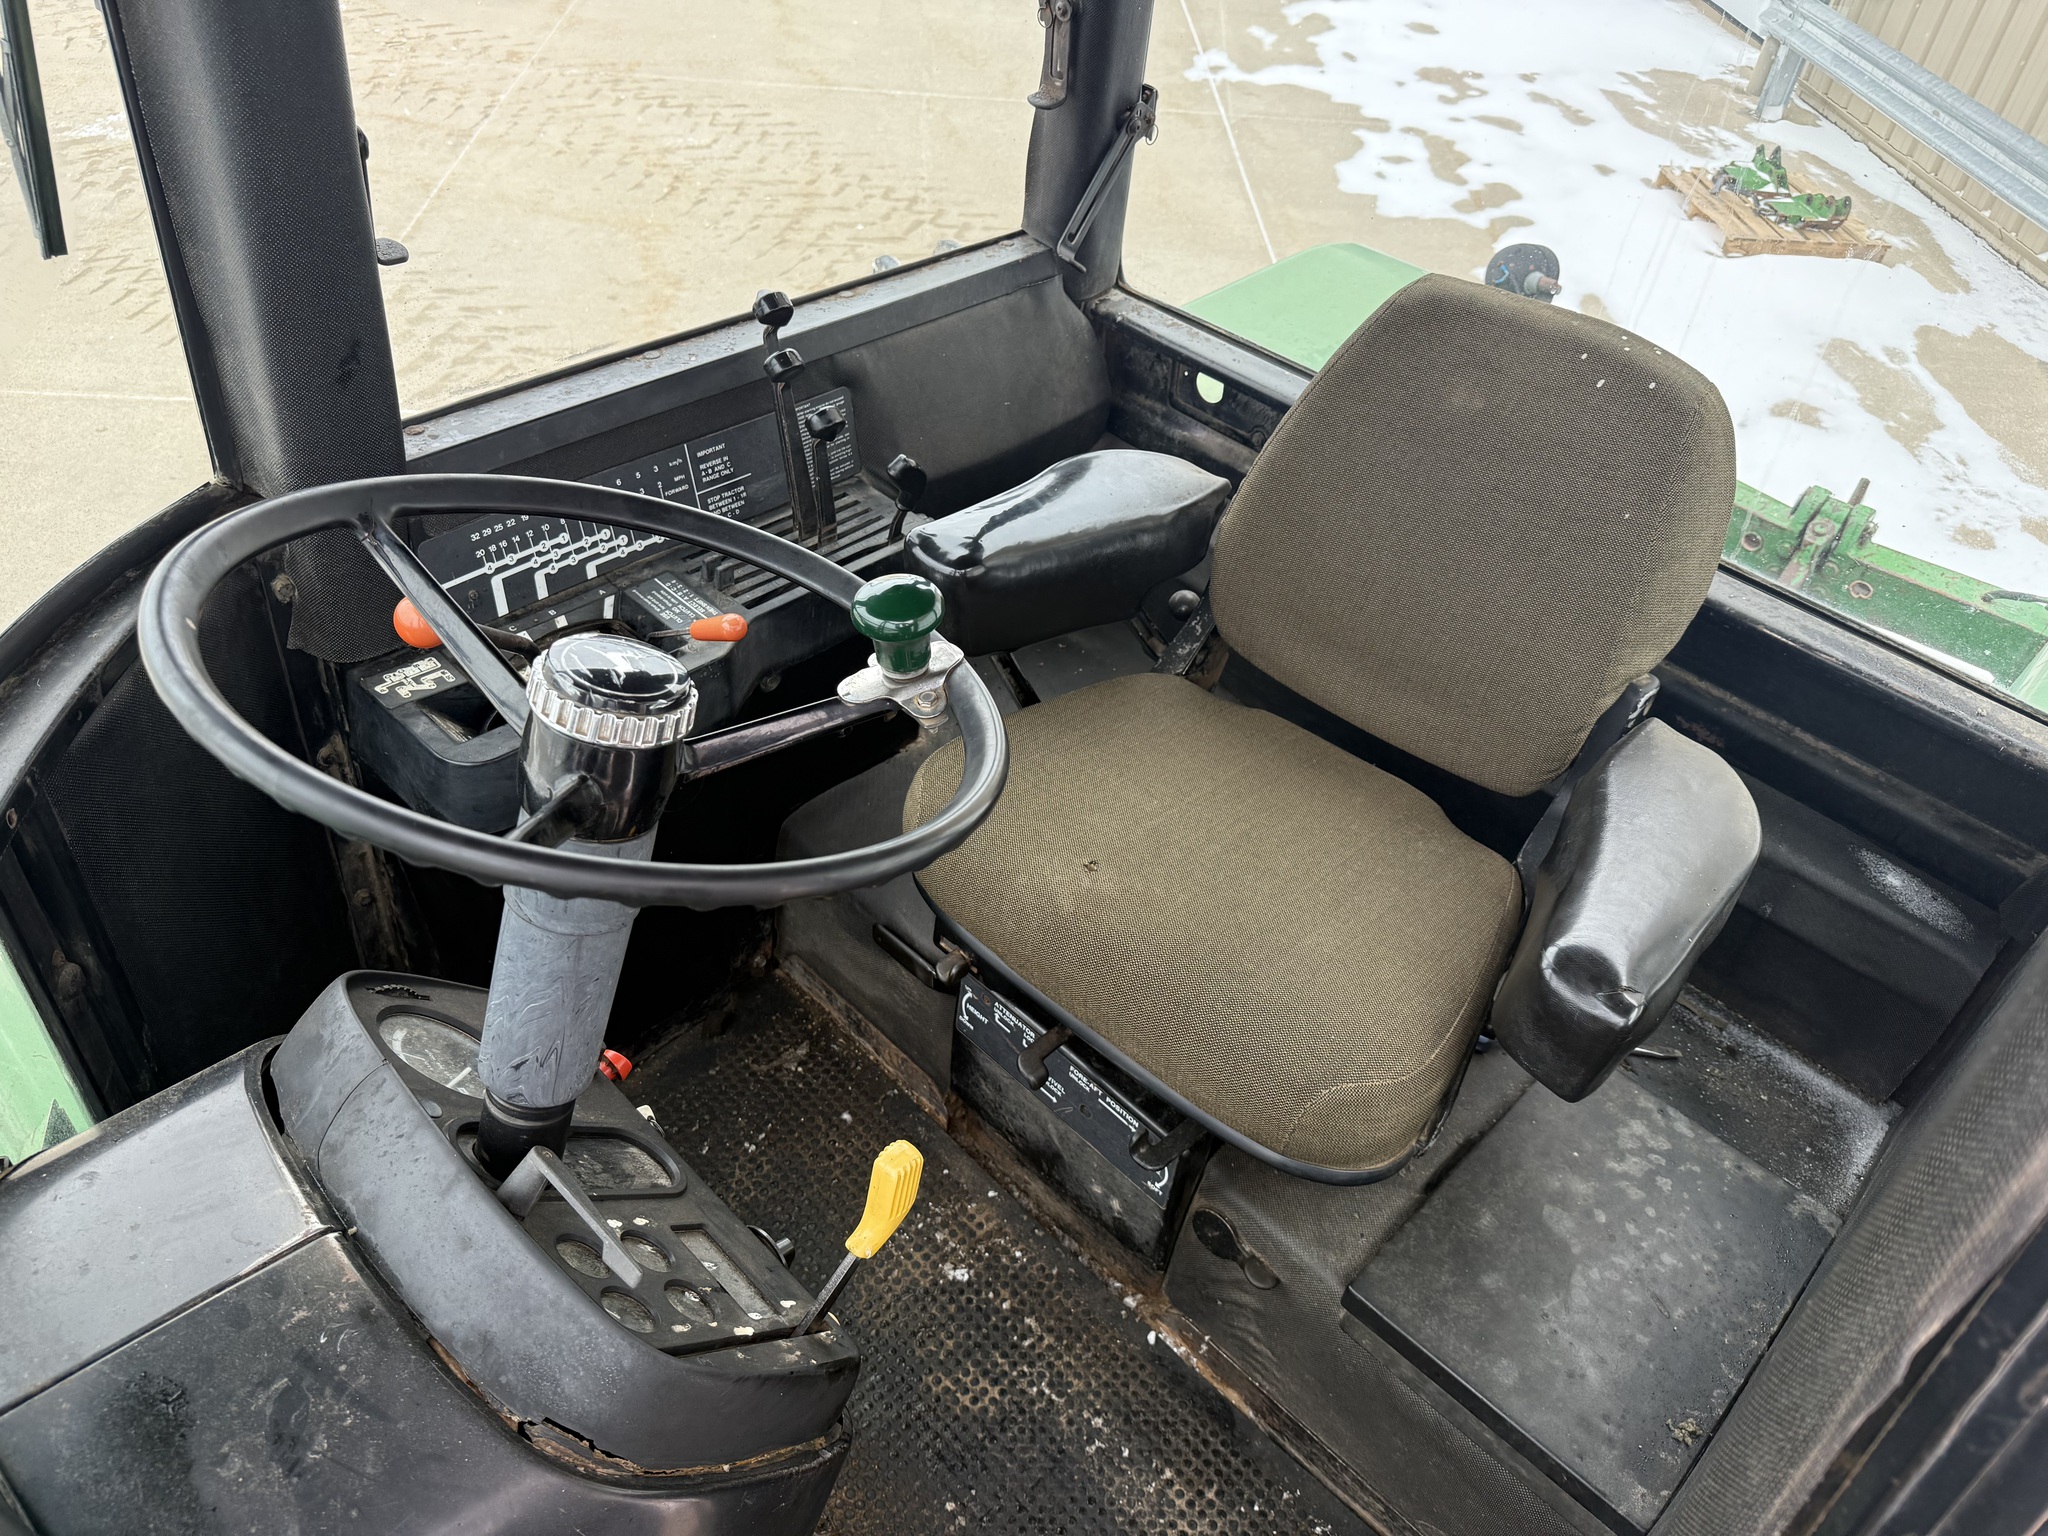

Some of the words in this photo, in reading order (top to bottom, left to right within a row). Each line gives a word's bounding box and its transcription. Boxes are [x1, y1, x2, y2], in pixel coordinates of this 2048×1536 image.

[696, 443, 726, 458] IMPORTANT
[699, 458, 722, 470] REVERSE
[714, 463, 726, 472] AND
[702, 473, 720, 483] RANGE
[720, 467, 735, 477] ONLY
[665, 484, 689, 497] FORWARD
[707, 495, 720, 504] STOP
[721, 486, 745, 499] TRACTOR
[470, 532, 481, 542] 32
[482, 527, 492, 537] 29
[494, 523, 504, 532] 25
[506, 518, 516, 528] 22
[520, 514, 529, 522] 19
[635, 471, 641, 479] 5
[653, 465, 659, 473] 3
[668, 458, 683, 467] km/h
[708, 498, 733, 511] BETWEEN
[722, 500, 745, 512] BETWEEN
[475, 549, 486, 558] 20
[488, 544, 497, 553] 18
[498, 540, 508, 548] 16
[511, 535, 521, 543] 14
[525, 530, 534, 538] 12
[541, 523, 550, 532] 10
[674, 474, 686, 482] MPH
[677, 605, 695, 618] CLUTCH
[688, 601, 705, 612] SELECT
[665, 610, 683, 623] CLUTCH
[966, 1003, 989, 1024] HEIGHT
[994, 1001, 1036, 1039] ATTENUATOR
[959, 1015, 974, 1030] DOWN
[993, 1007, 1015, 1027] UNLOCK
[1023, 1032, 1035, 1043] LOC
[1069, 1071, 1091, 1093] UNLOCK
[1070, 1065, 1103, 1096] FORE-AFT
[1106, 1096, 1139, 1128] POSITION
